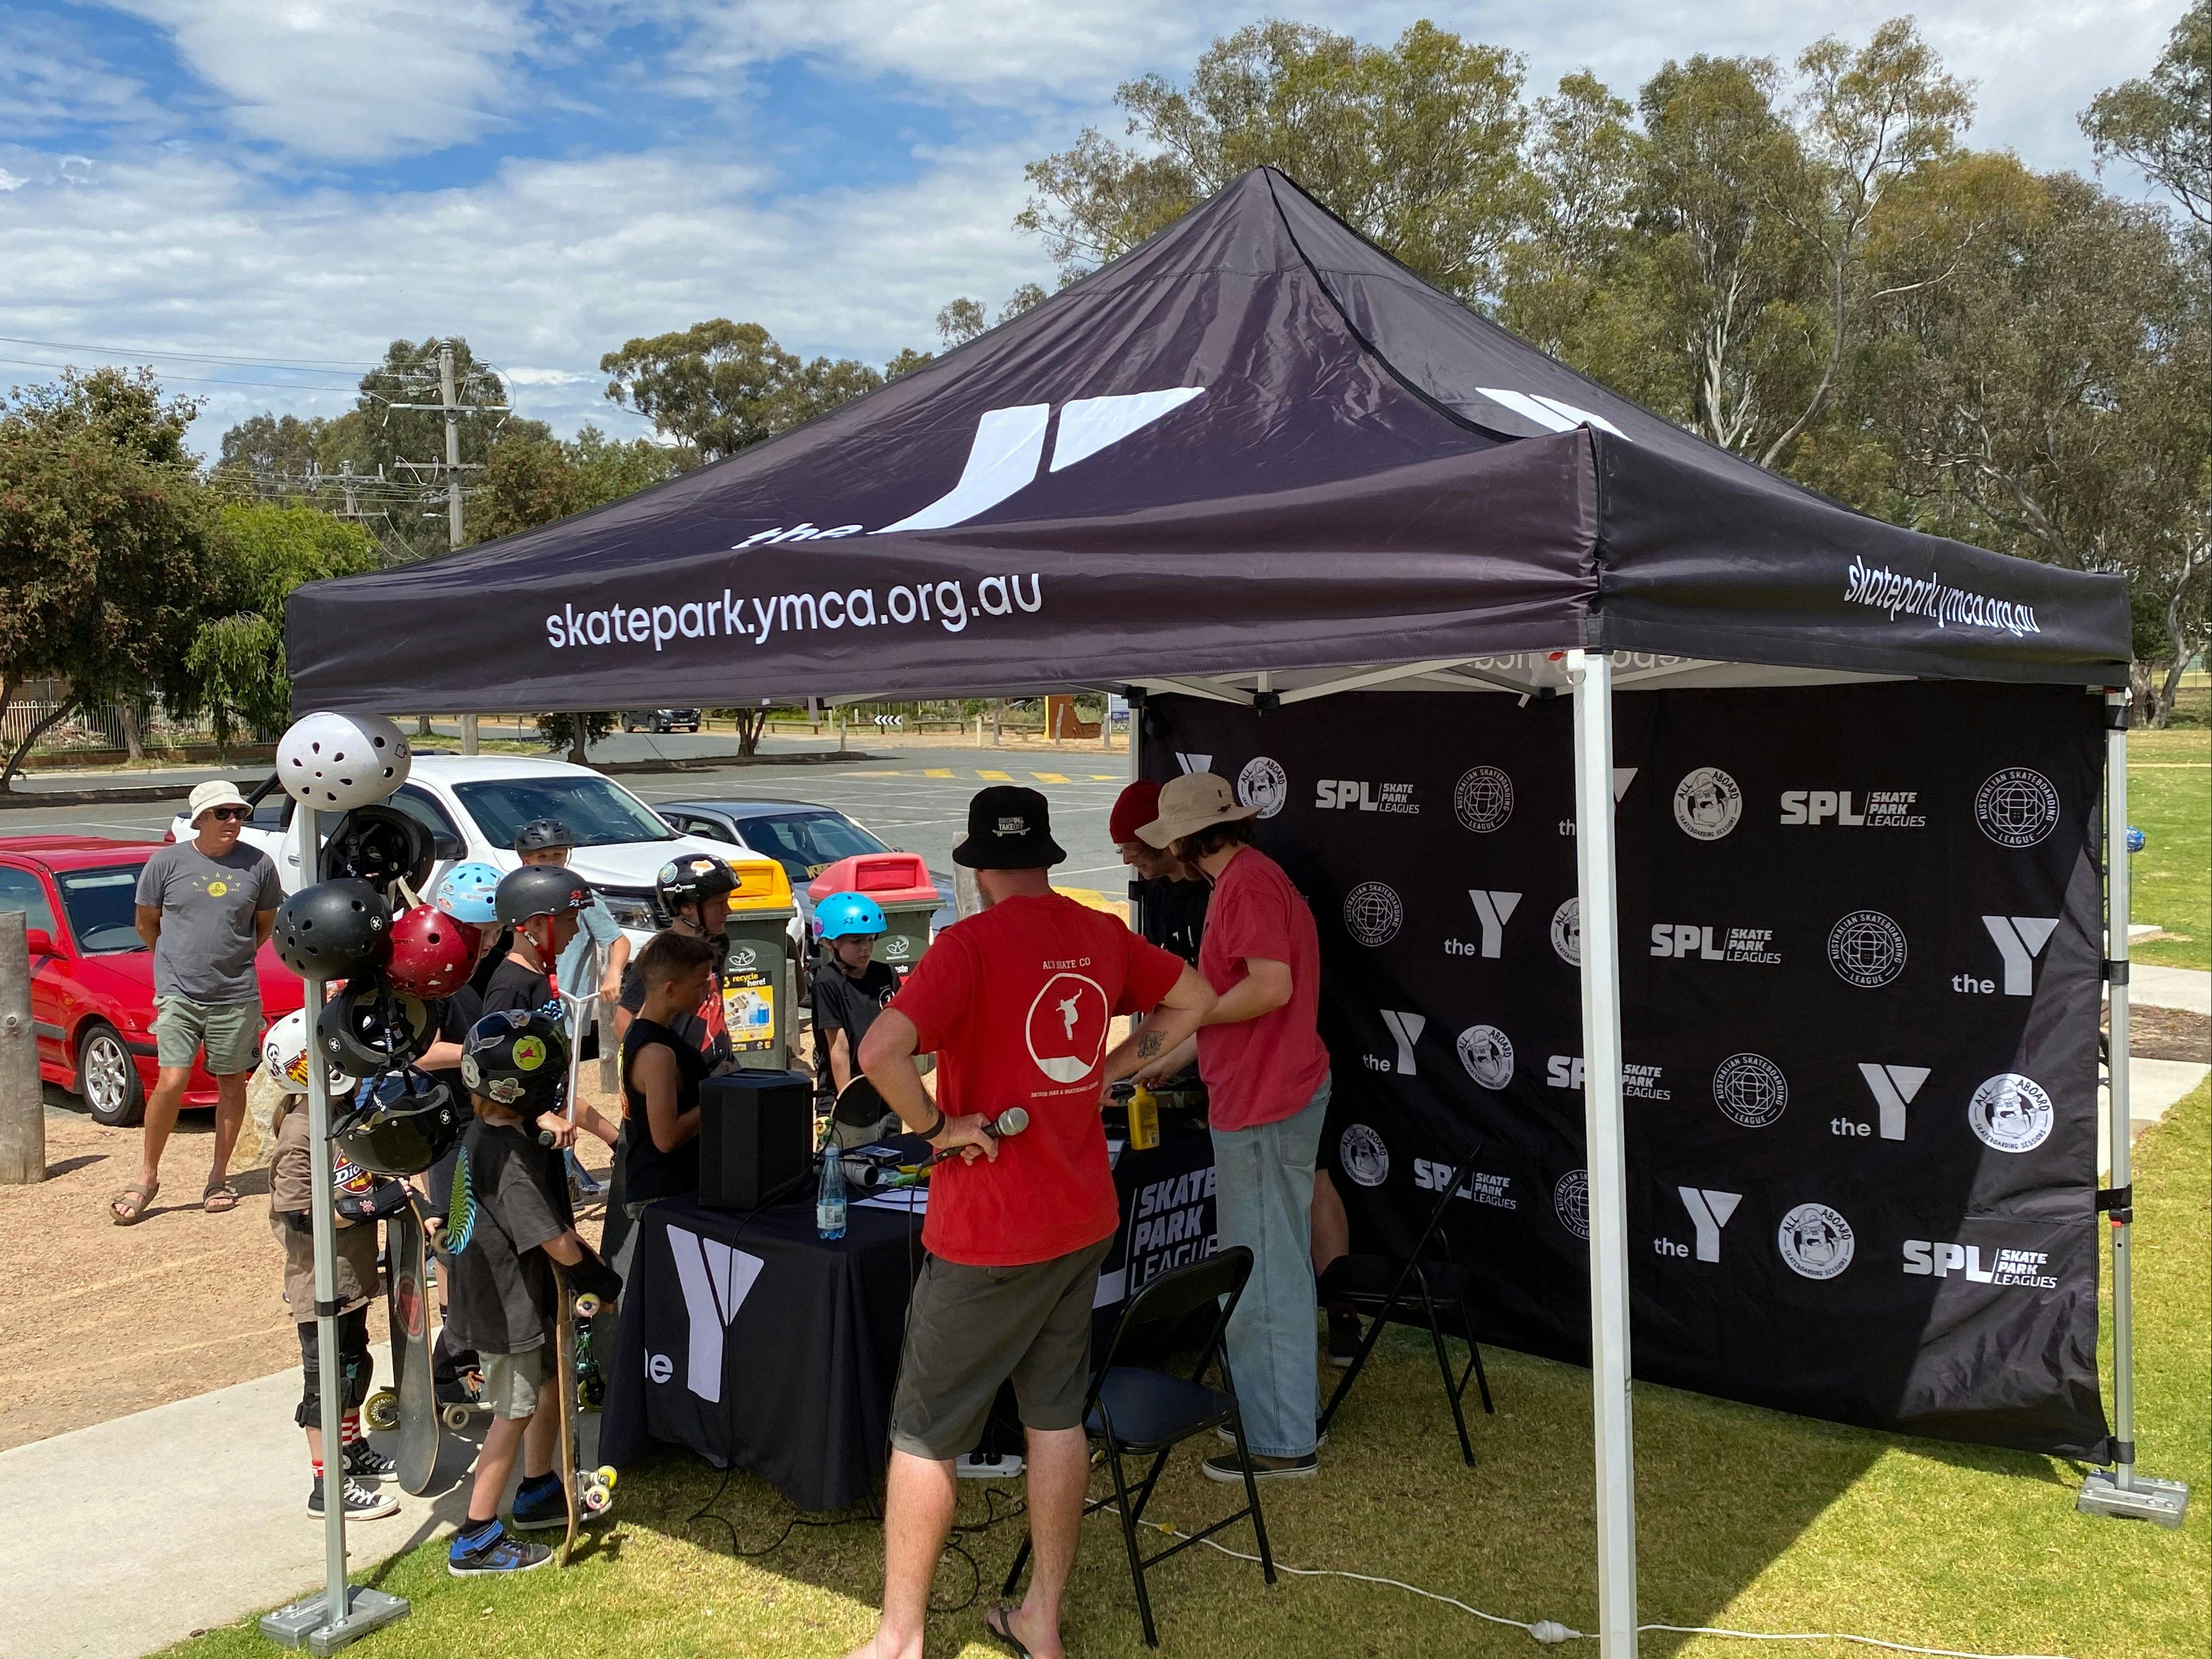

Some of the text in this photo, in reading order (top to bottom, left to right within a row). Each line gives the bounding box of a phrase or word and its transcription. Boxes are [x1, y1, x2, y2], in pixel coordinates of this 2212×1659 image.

[731, 523, 863, 550] the
[1844, 555, 2040, 637] skatepark.ymca.org.au
[546, 573, 1042, 651] skatepark.ymca.org.au
[1265, 760, 1285, 785] ABOARD
[1678, 770, 1739, 800] ALL ABOARD
[1315, 779, 1378, 811] SPL
[1381, 793, 1408, 803] PARK
[1383, 783, 1414, 793] SKATE
[1457, 769, 1511, 811] AUSTRALIAN SKATEBOARDING
[1871, 792, 1917, 803] SKATE
[1978, 771, 2056, 822] AUSTRALIAN SKATEBOARDING
[1379, 803, 1420, 814] LEAGUES
[1780, 791, 1865, 826] SPL
[1866, 815, 1926, 827] LEAGUES
[1869, 804, 1908, 814] PARK
[1469, 820, 1495, 830] LEAGUE
[1558, 819, 1576, 836] th
[1998, 833, 2035, 844] LEAGUE
[1346, 886, 1367, 922] AUSTRALIAN
[1369, 884, 1400, 927] SKATEBOARDING
[1444, 889, 1523, 958] the Y
[1555, 910, 1568, 927] ALL
[1359, 934, 1382, 944] LEAGUE
[1650, 923, 1724, 960] SPL
[1729, 940, 1765, 951] PARK
[1730, 928, 1773, 940] SKATE
[1831, 914, 1903, 964] AUSTRALIAN SKATEBOARDING
[1079, 957, 1090, 967] CO
[1727, 951, 1781, 964] LEAGUES
[1951, 915, 2060, 996] the Y
[732, 972, 759, 983] recycle
[746, 977, 766, 987] here!
[1850, 973, 1884, 984] LEAGUE
[1362, 1009, 1425, 1076] the Y
[1489, 1029, 1512, 1058] ABOARD
[1547, 1054, 1585, 1090] SP
[1622, 1075, 1654, 1087] PARK
[1623, 1064, 1662, 1077] SKATE
[1716, 1056, 1784, 1106] AUSTRALIAN SKATEBOARDING
[1830, 1063, 1932, 1141] the Y
[1975, 1079, 2050, 1111] ALL ABOARD
[1735, 1113, 1767, 1124] LEAGUE
[1365, 1129, 1386, 1156] ABOARD
[1976, 1123, 2046, 1149] SKATEBOARDING SESSIONS
[1139, 1166, 1217, 1218] SKATE
[1474, 1183, 1503, 1197] PARK
[1475, 1172, 1511, 1187] SKATE
[1557, 1173, 1578, 1211] AUSTRALIAN
[1474, 1192, 1517, 1210] LEAGUES
[1134, 1204, 1204, 1257] PARK
[1653, 1186, 1743, 1263] the Y
[1784, 1209, 1852, 1240] ALL ABOARD
[1785, 1250, 1848, 1276] SKATEBOARDING SESSIONS
[1903, 1239, 1993, 1283] SPL
[1998, 1261, 2038, 1275] PARK
[2000, 1249, 2048, 1264] SKATE
[1994, 1273, 2058, 1289] LEAGUES
